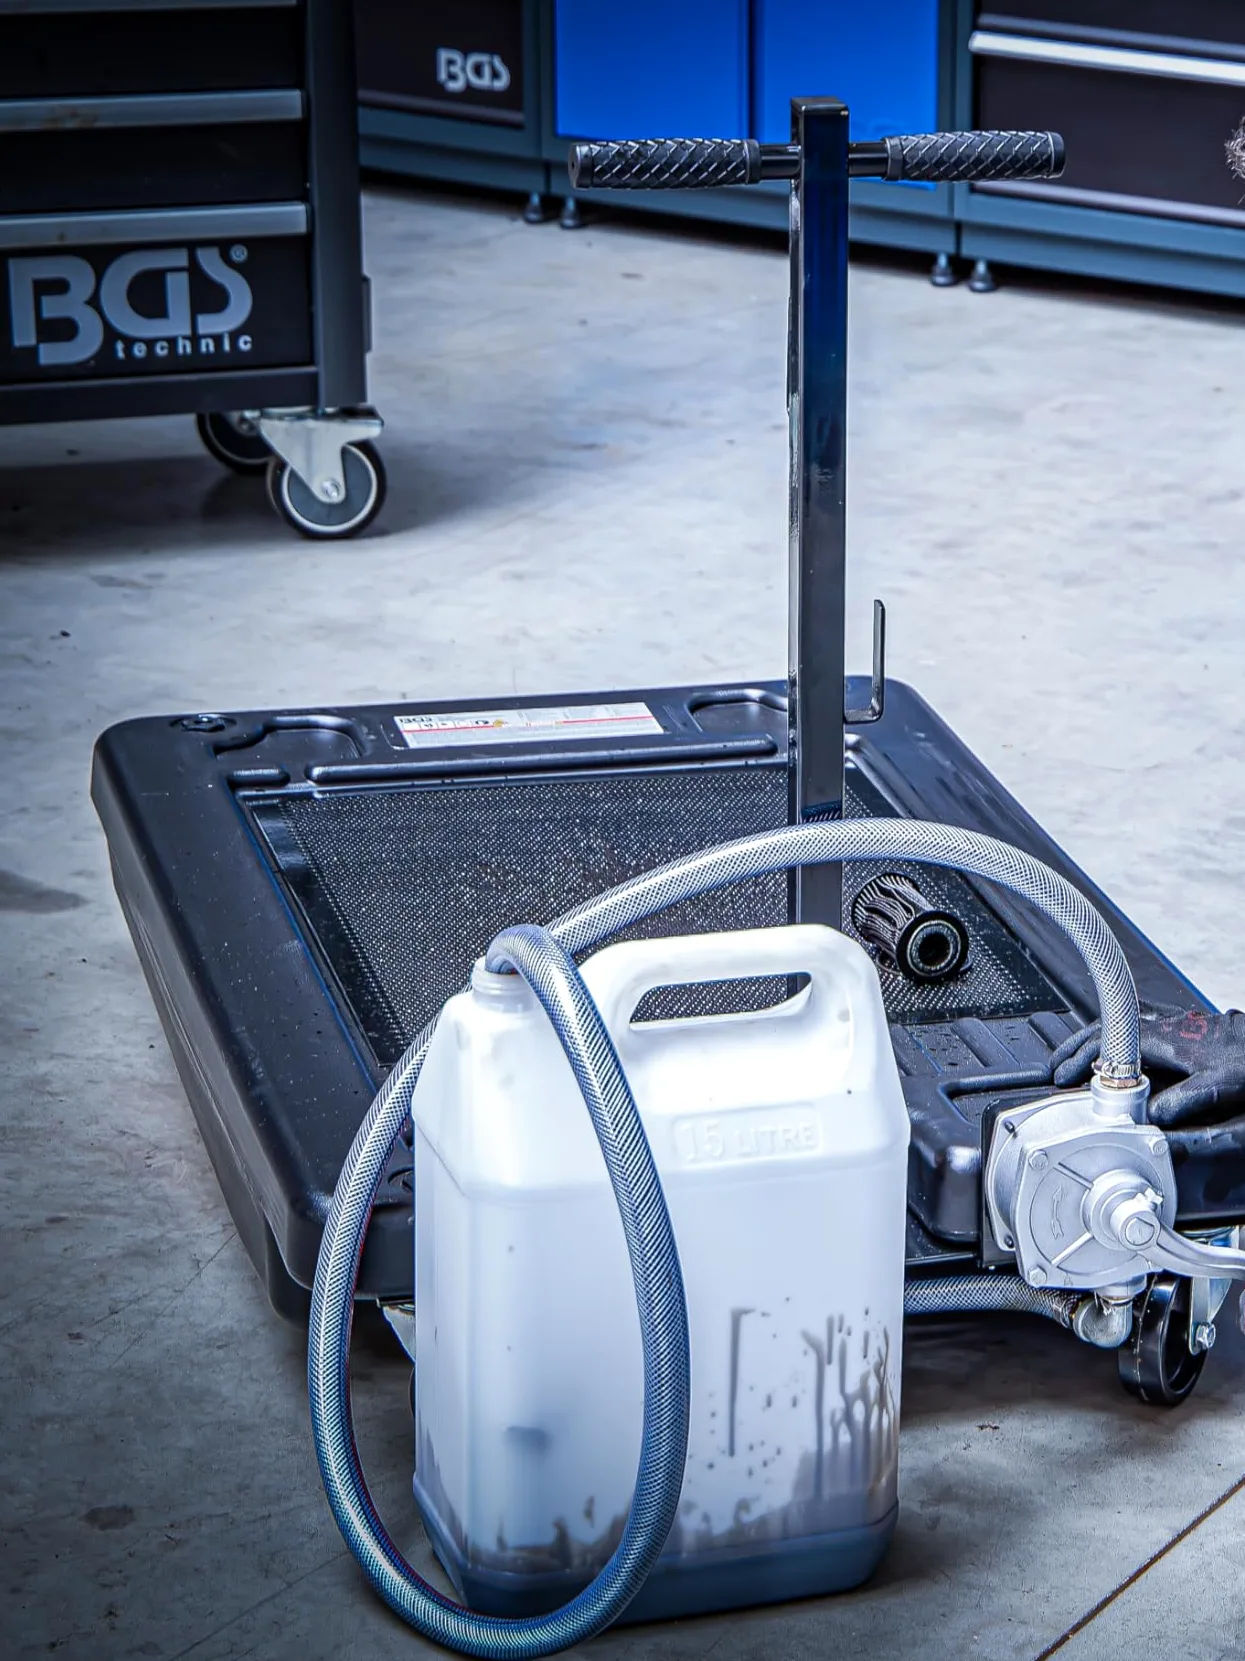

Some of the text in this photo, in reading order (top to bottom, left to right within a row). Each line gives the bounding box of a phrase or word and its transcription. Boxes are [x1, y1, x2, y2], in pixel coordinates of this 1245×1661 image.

[436, 47, 511, 92] BGS
[115, 333, 253, 359] technic
[678, 1119, 817, 1161] 15 LITRE
